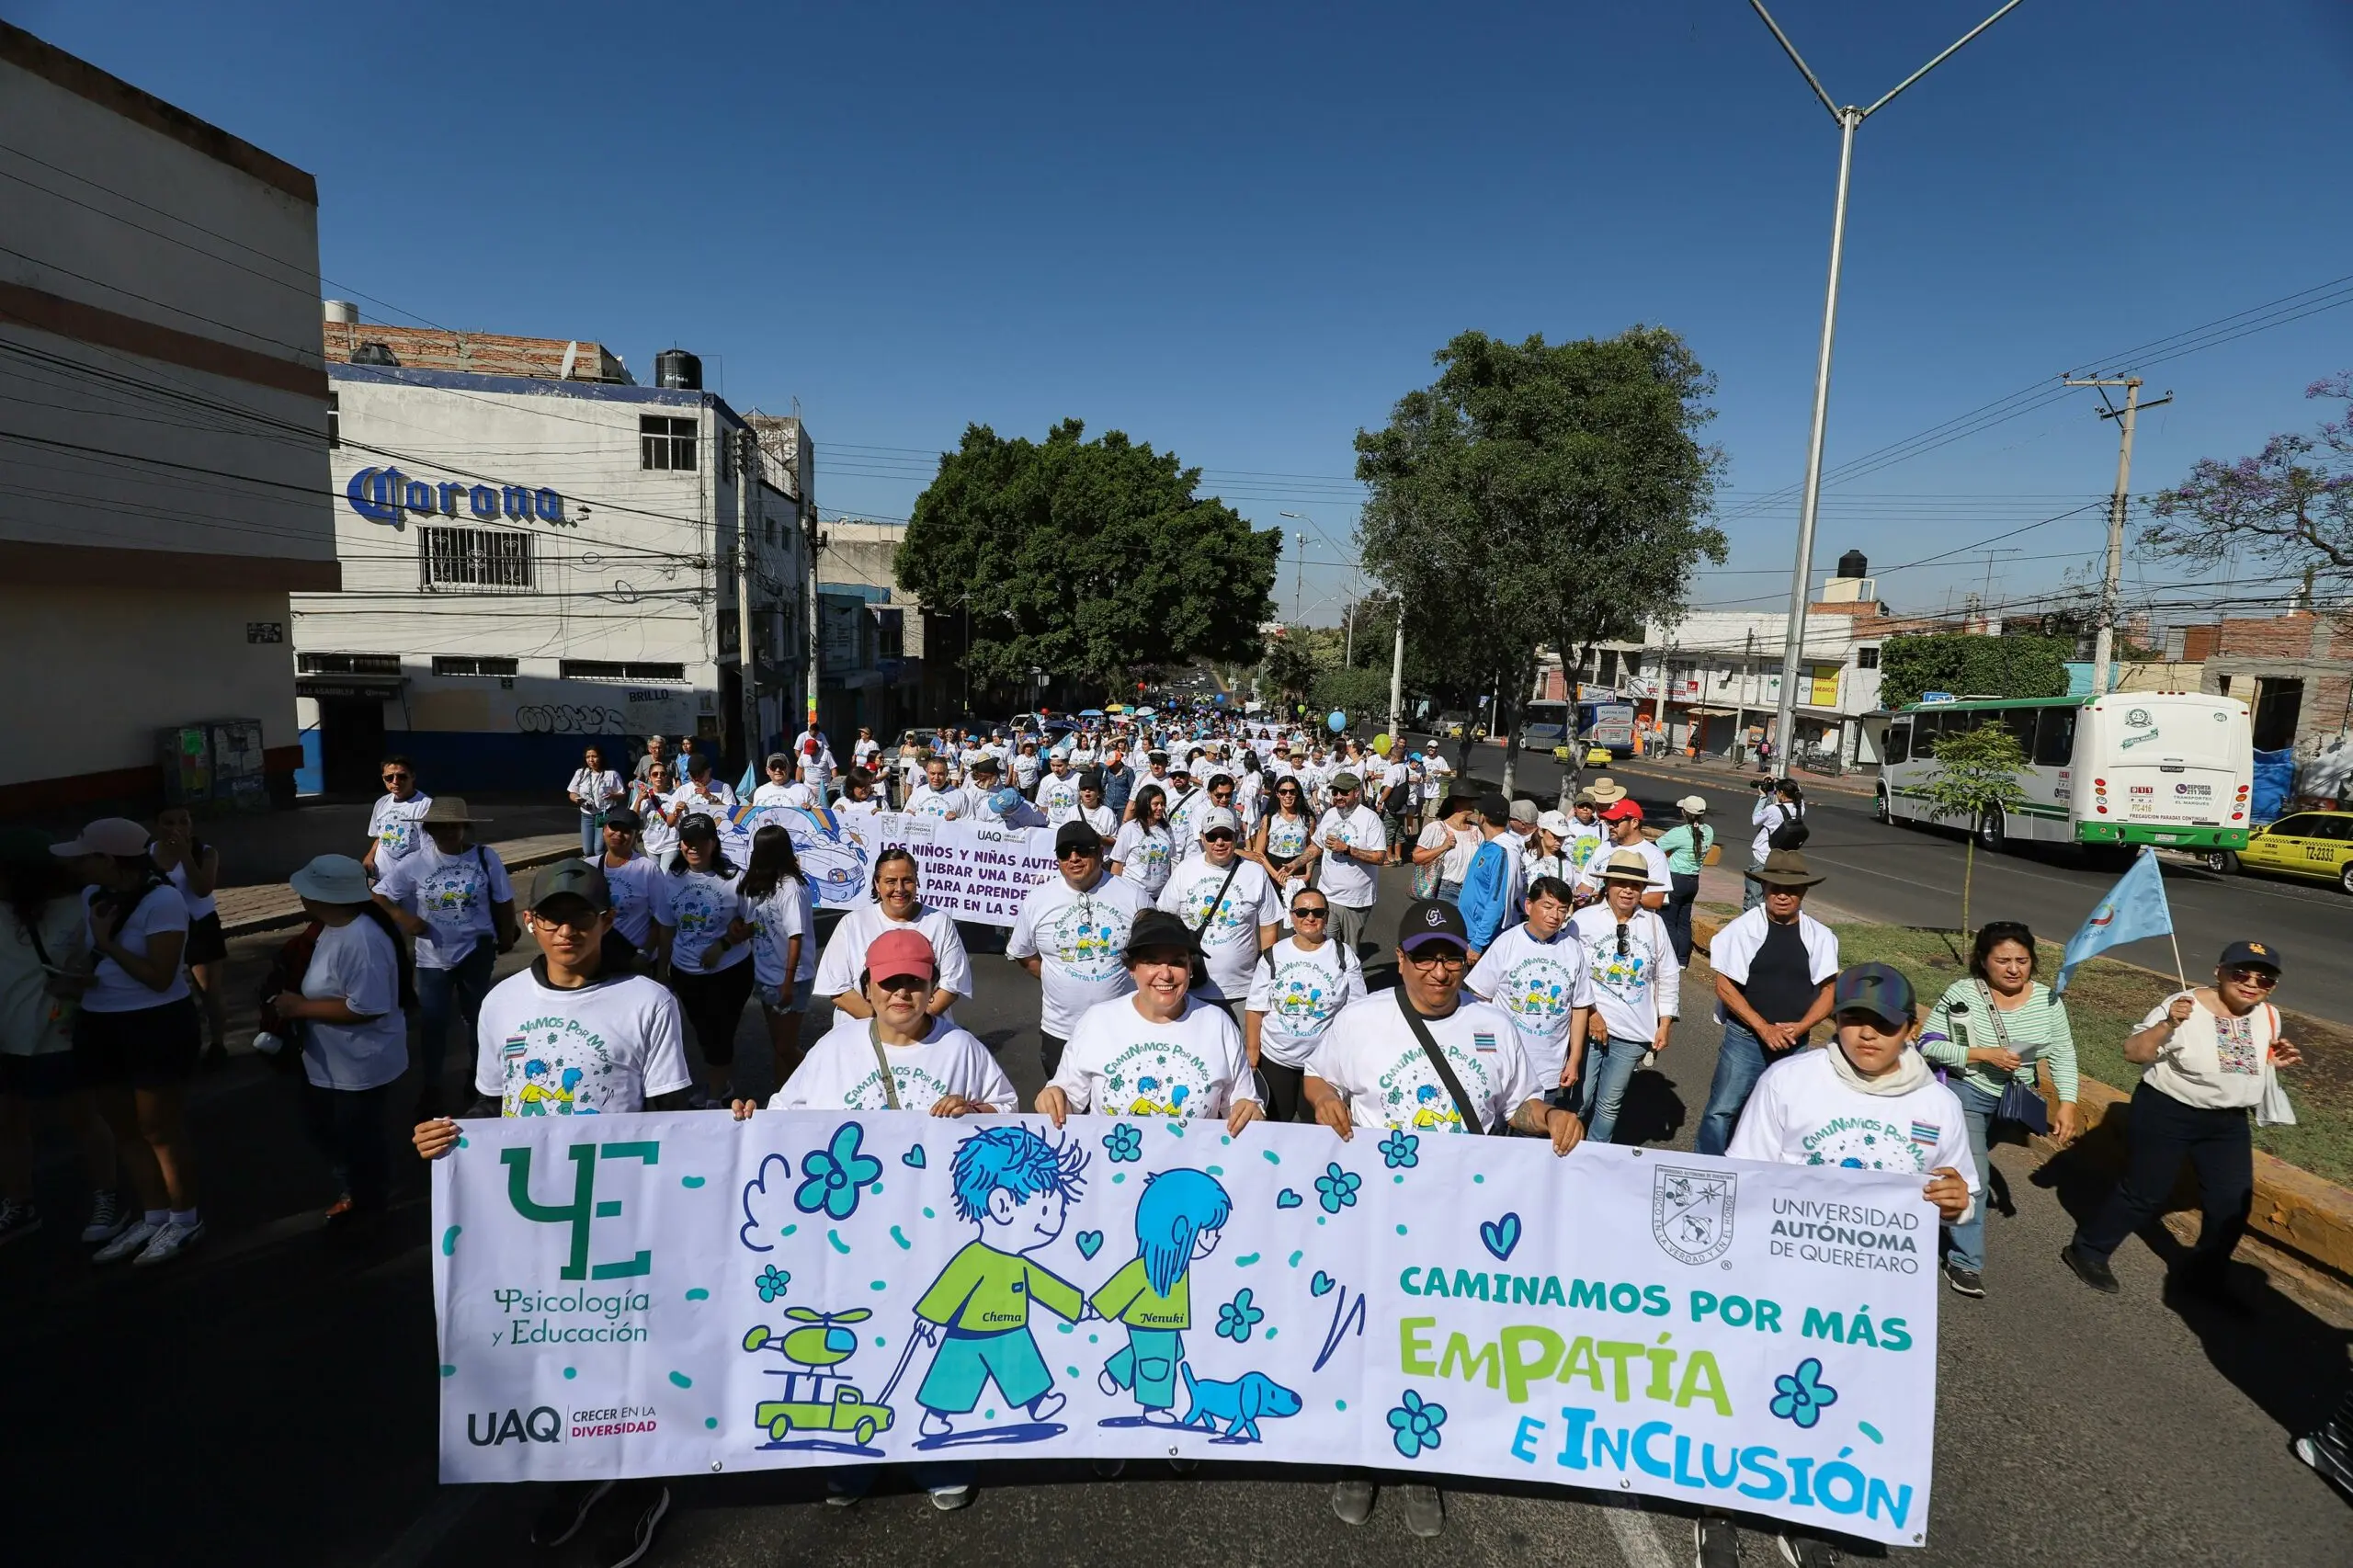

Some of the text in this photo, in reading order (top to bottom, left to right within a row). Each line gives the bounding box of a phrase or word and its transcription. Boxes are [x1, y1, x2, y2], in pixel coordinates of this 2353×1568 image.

[347, 466, 565, 527] Corona
[629, 689, 669, 702] BRILLO
[977, 830, 1002, 842] UAQ
[912, 842, 953, 858] NIÑOS
[959, 849, 970, 860] Y
[973, 849, 1017, 866] NIÑAS
[2306, 846, 2334, 862] TZ-2333
[925, 861, 972, 878] LIBRAR
[978, 868, 1006, 882] UNA
[926, 878, 961, 892] PARA
[967, 883, 1031, 900] APRENDE
[963, 898, 980, 912] EN
[985, 901, 1004, 915] LA
[1509, 957, 1550, 978] CAMINAMOS
[565, 1019, 589, 1038] POR
[1104, 1042, 1170, 1074] CAMINAMOS
[1172, 1044, 1192, 1060] POR
[1448, 1044, 1469, 1061] POR
[913, 1067, 932, 1083] POR
[1802, 1117, 1881, 1151] CAMINAMOS
[1884, 1123, 1909, 1144] POR
[1654, 1185, 1664, 1216] EDUCO
[1724, 1195, 1733, 1224] HONOR
[1654, 1220, 1662, 1231] EN
[1772, 1199, 1919, 1232] UNIVERSIDAD
[1715, 1241, 1728, 1253] EN
[1770, 1220, 1917, 1255] AUTÓNOMA
[1669, 1245, 1706, 1264] VERDAD
[1769, 1240, 1919, 1275] DE QUERÉTARO
[983, 1312, 1022, 1323] Chema
[1140, 1312, 1185, 1324] Nenuki
[1399, 1267, 1913, 1352] CAMINAMOS POR MÁS
[492, 1319, 648, 1346] y Educación
[1400, 1316, 1733, 1417] EMPATÍA
[572, 1406, 656, 1423] CRECER EN LA
[467, 1406, 562, 1448] UAQ
[572, 1421, 657, 1438] DIVERSIDAD
[1510, 1406, 1913, 1529] E INCLUSIÓN
